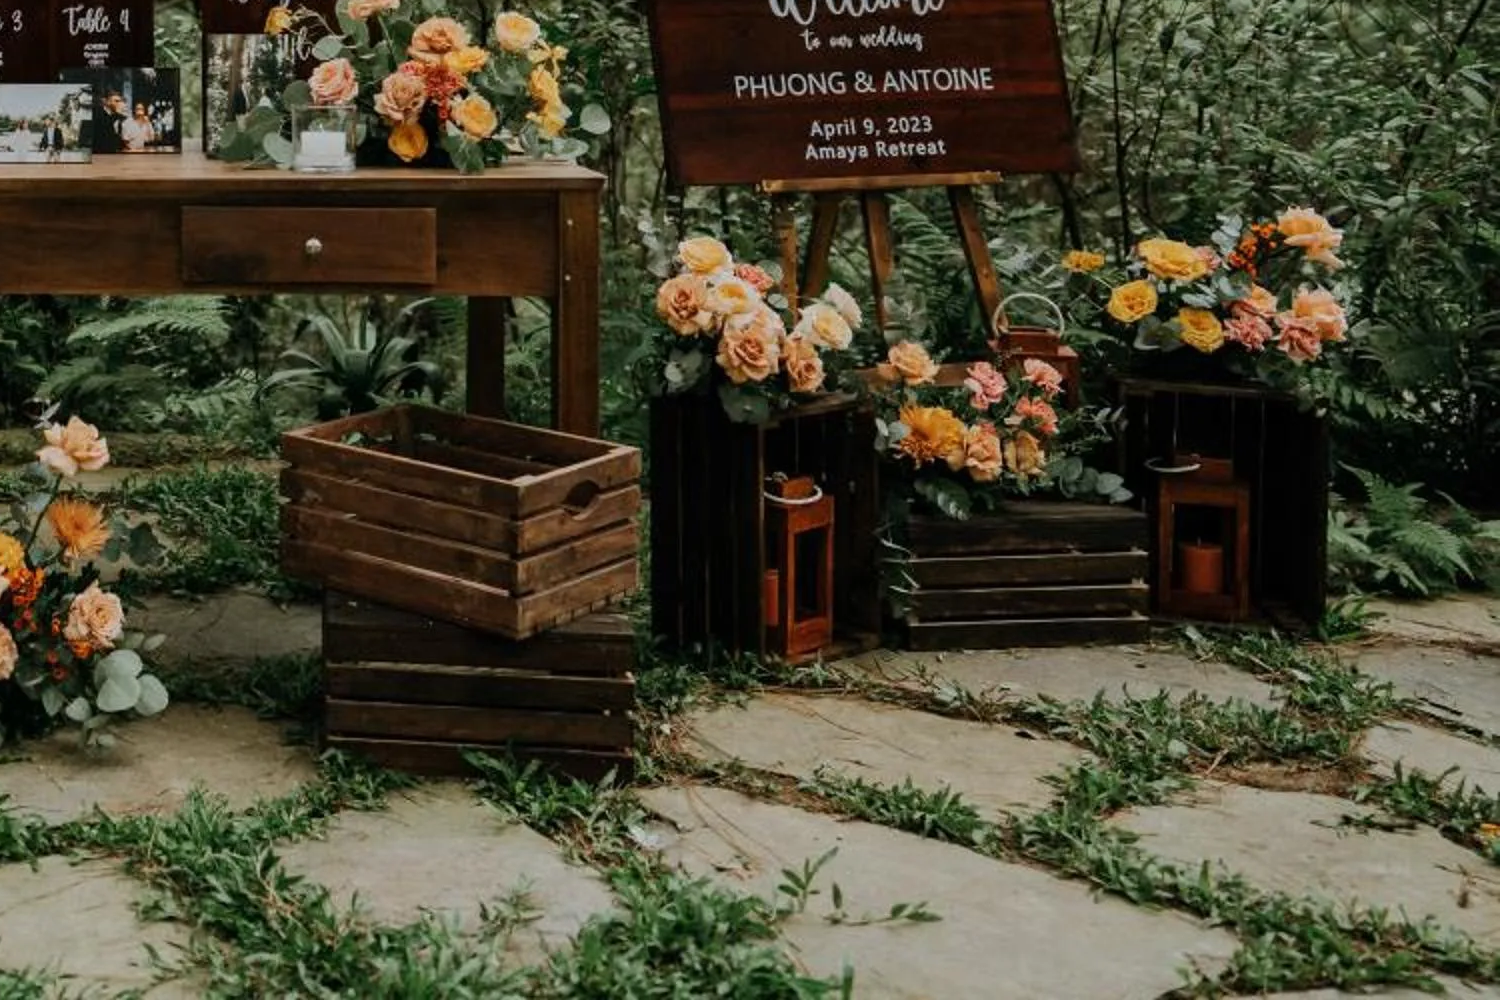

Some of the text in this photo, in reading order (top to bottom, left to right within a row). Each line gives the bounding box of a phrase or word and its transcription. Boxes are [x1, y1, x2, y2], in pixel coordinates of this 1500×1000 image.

[11, 9, 24, 32] 3
[62, 4, 130, 37] Table 4
[800, 26, 923, 52] to our wedding
[734, 66, 995, 98] PHUONG & ANTOINE
[810, 115, 933, 143] April 9, 2023
[805, 139, 946, 163] Amaya Retreat
